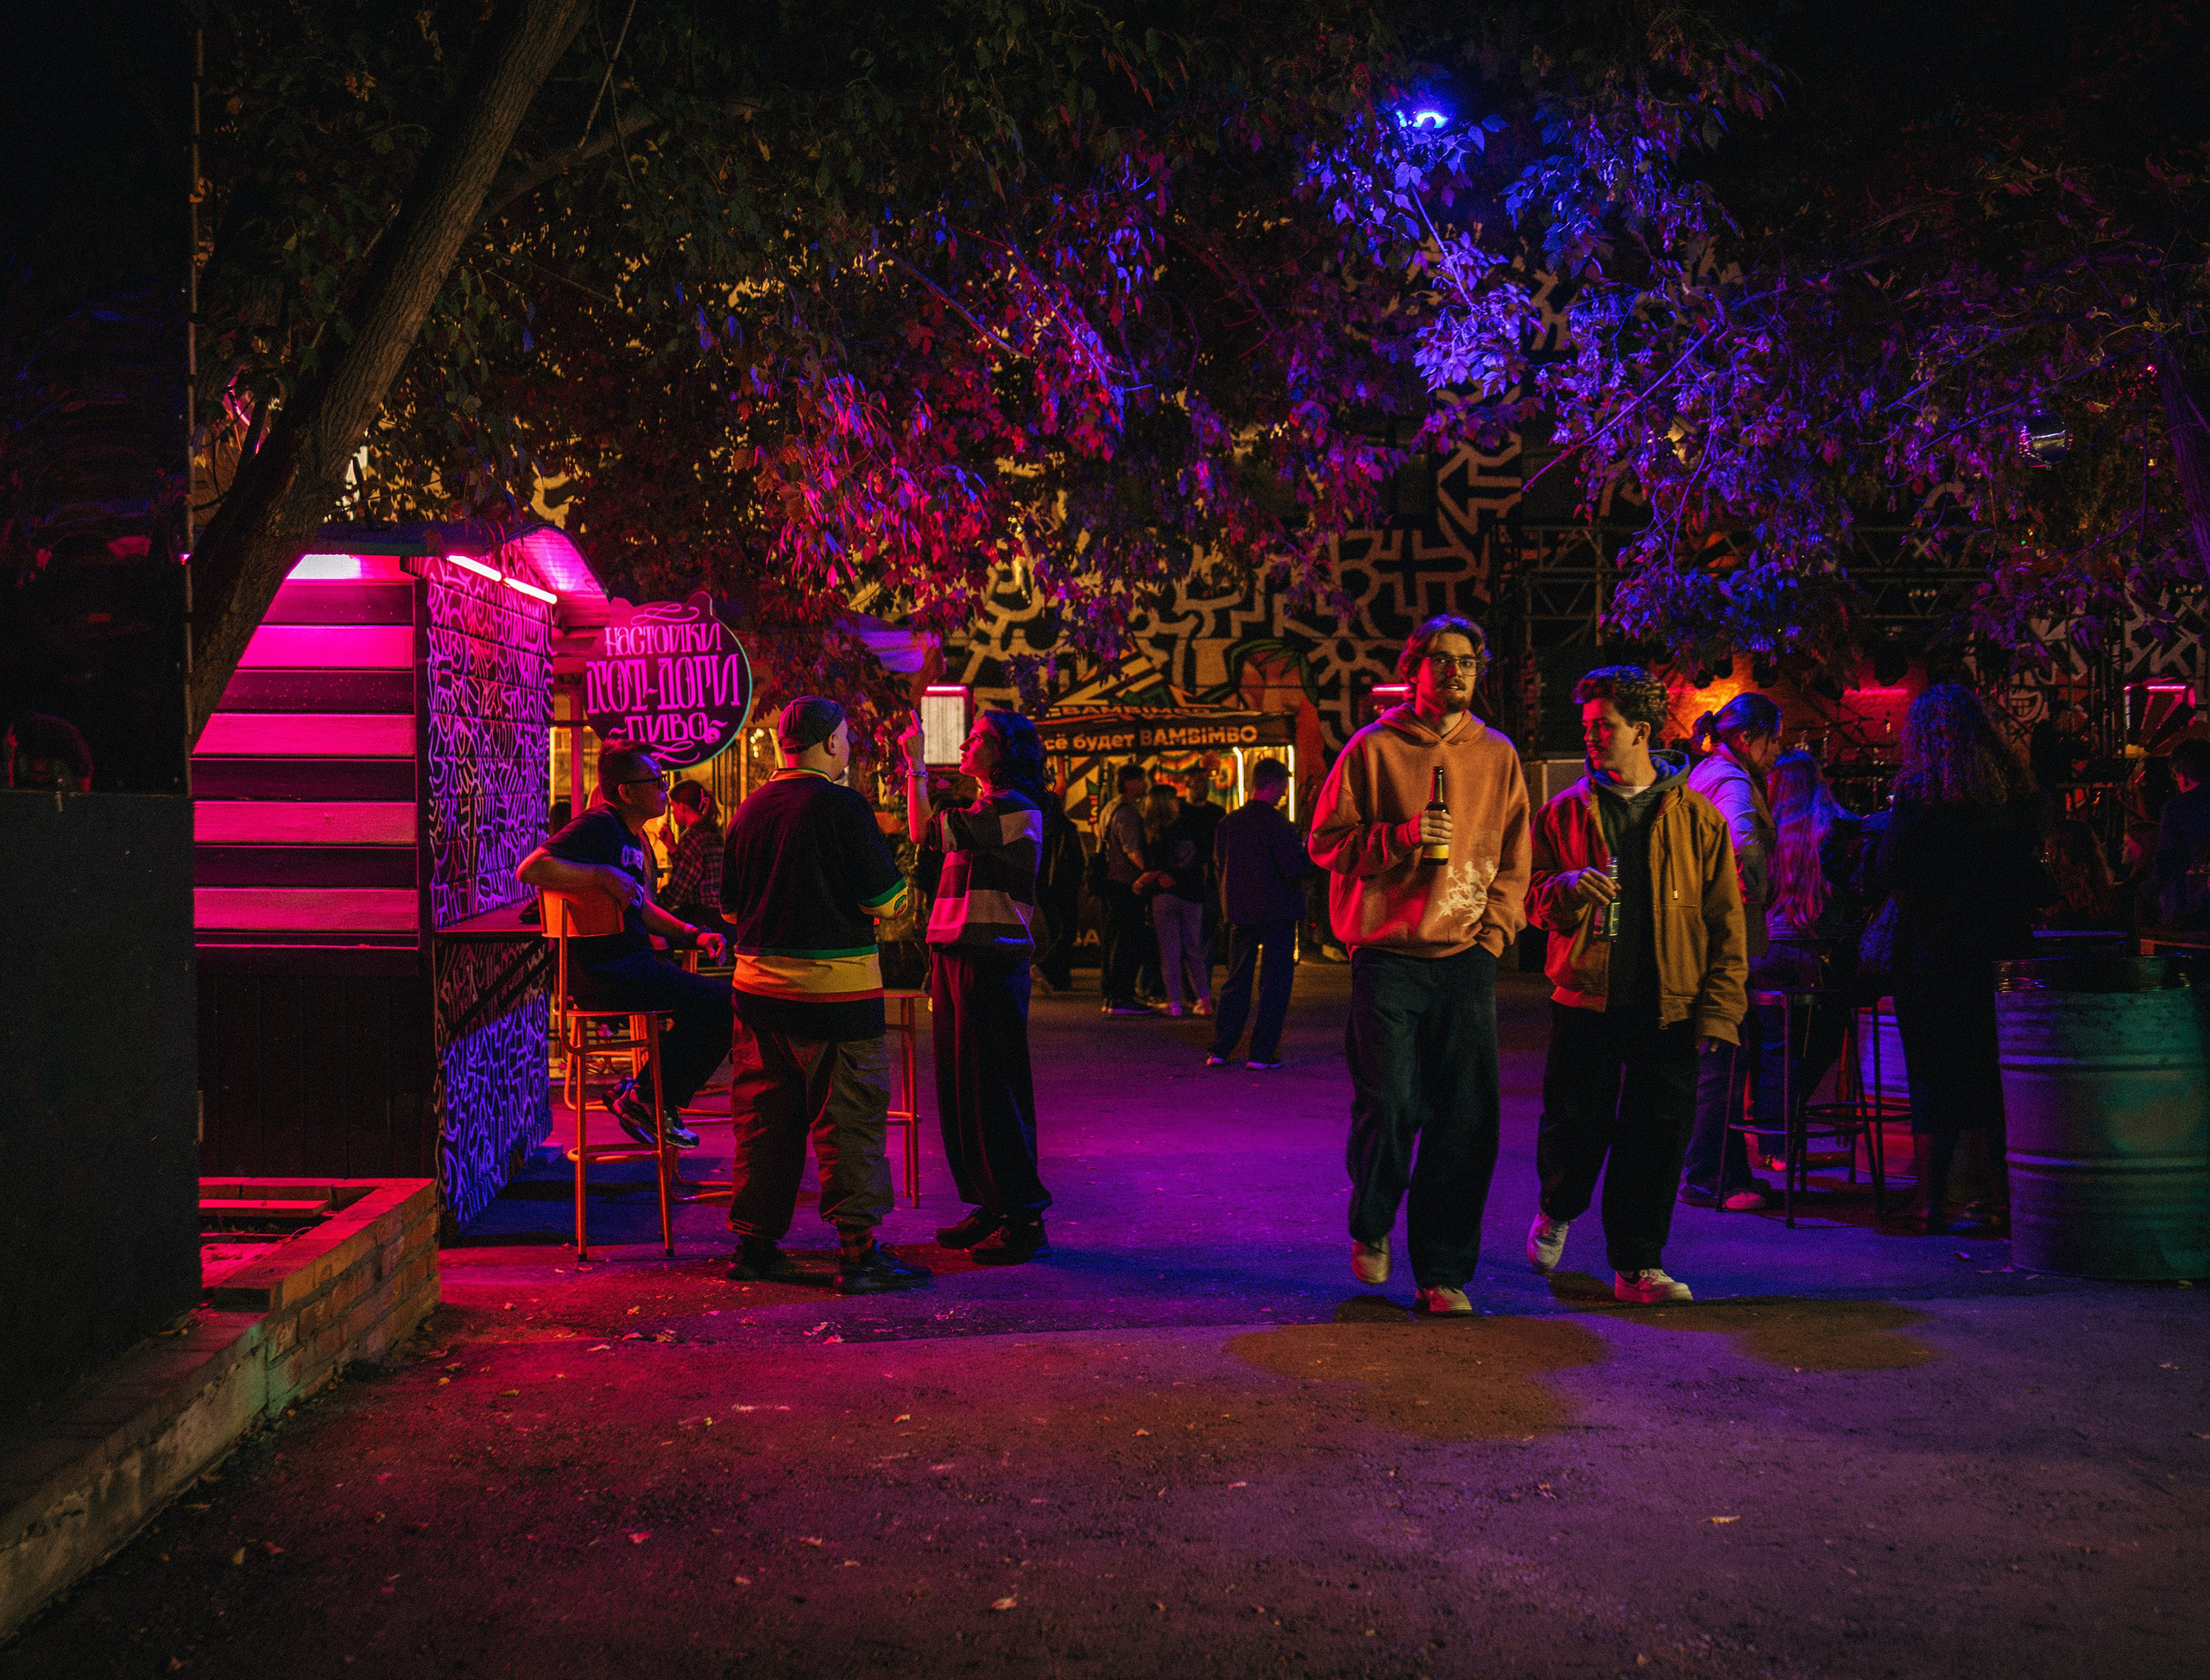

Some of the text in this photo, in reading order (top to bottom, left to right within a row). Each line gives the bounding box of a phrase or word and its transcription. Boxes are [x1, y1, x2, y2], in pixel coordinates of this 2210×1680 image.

[585, 654, 741, 714] ХОТ-ДОГИ
[624, 711, 709, 742] ПИВО
[1044, 733, 1069, 750] сё
[1072, 733, 1135, 752] будет
